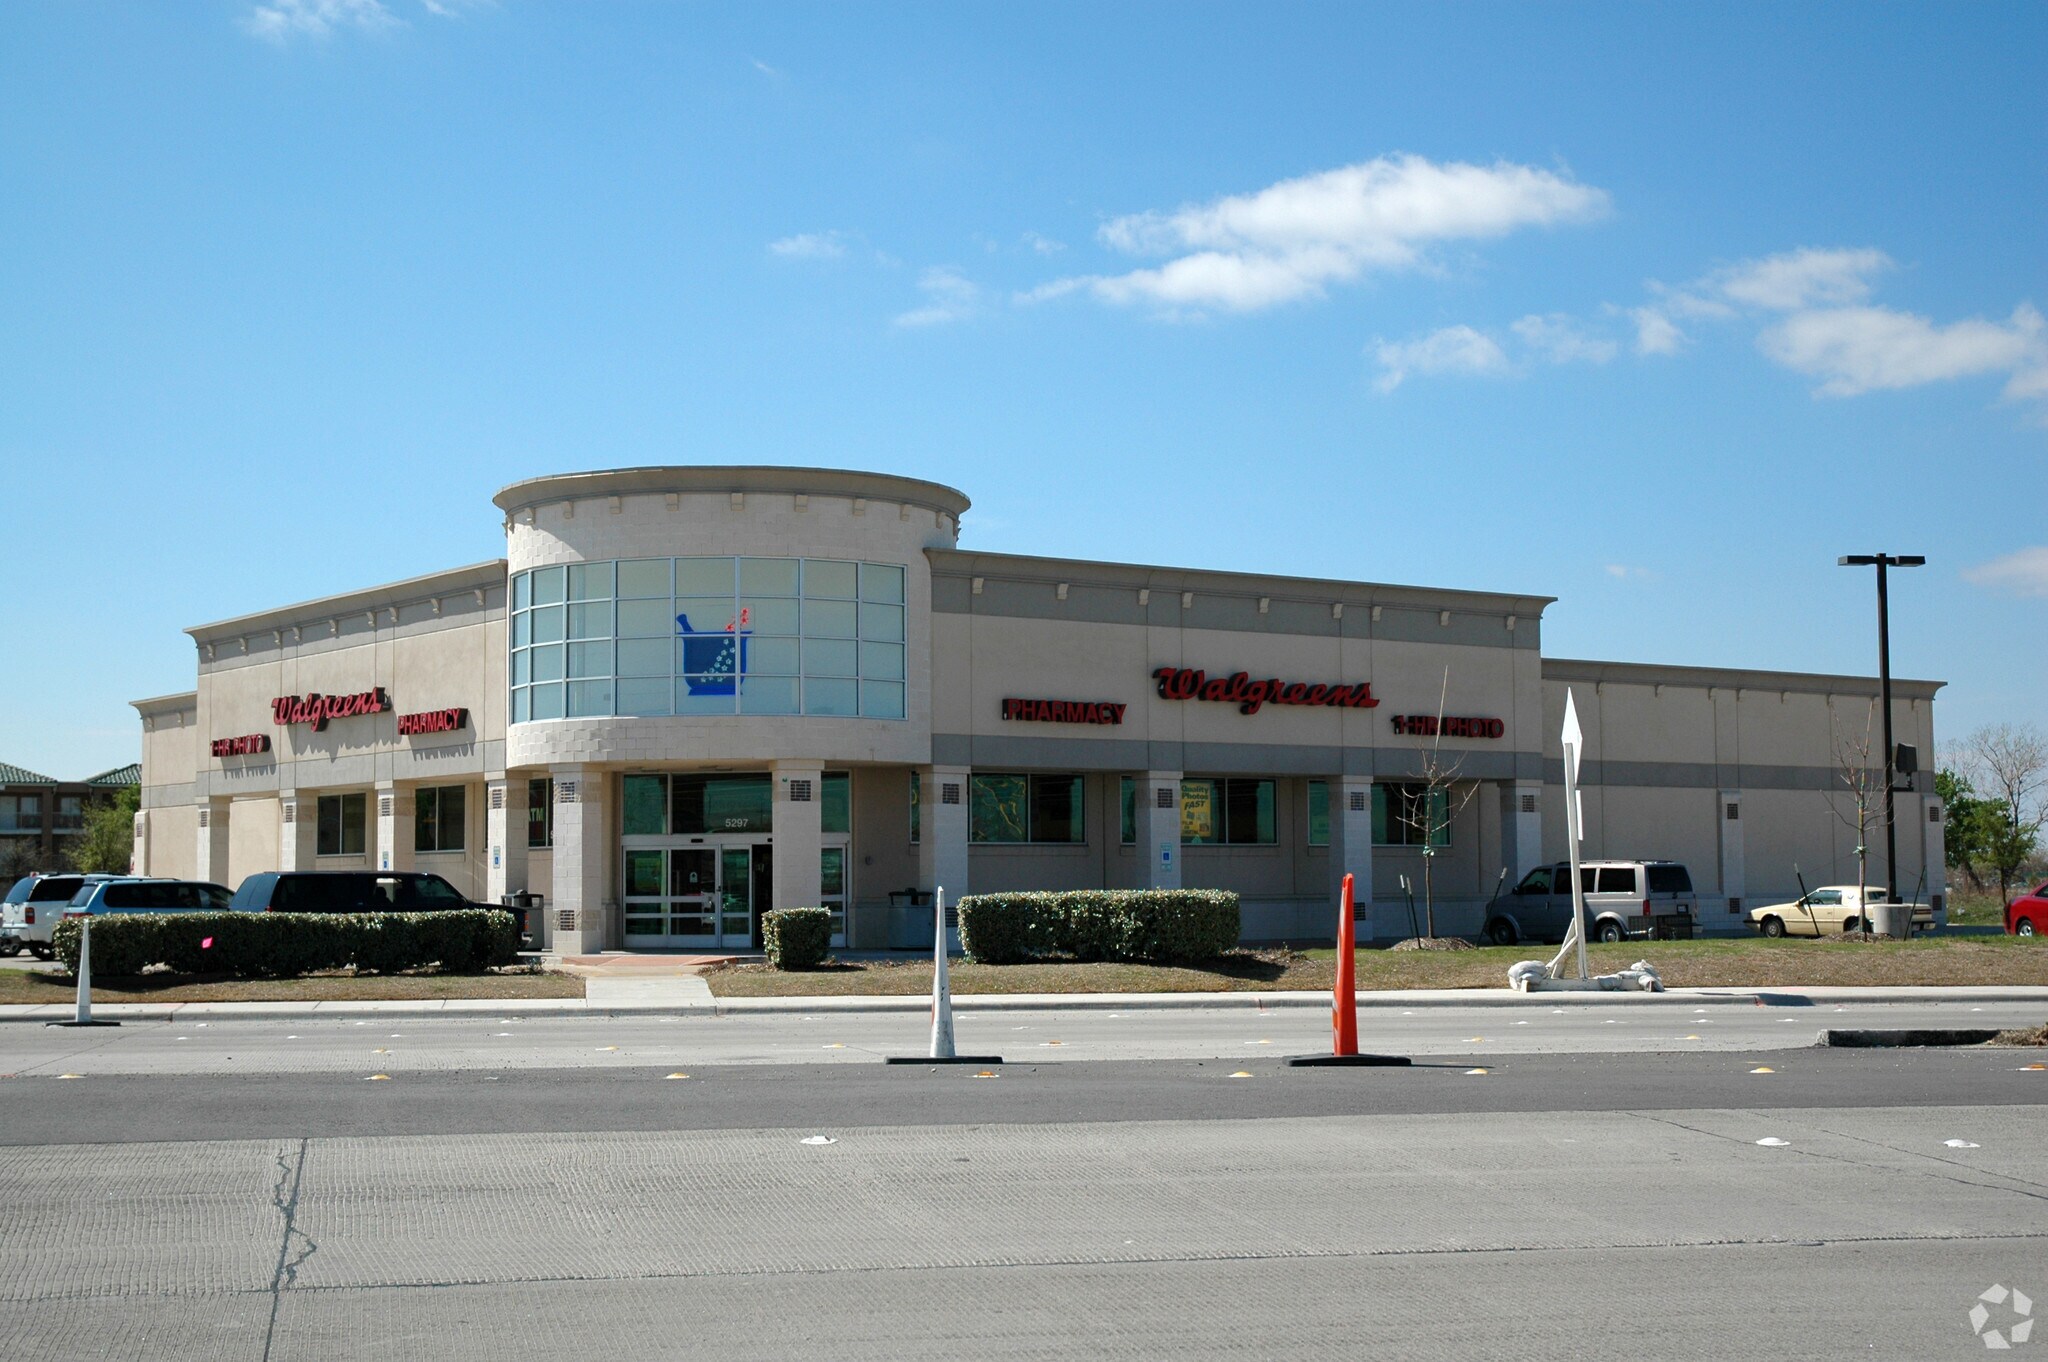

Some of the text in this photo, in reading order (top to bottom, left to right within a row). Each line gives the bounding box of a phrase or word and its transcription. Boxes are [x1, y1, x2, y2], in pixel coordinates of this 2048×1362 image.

[1155, 667, 1380, 715] Walgreens
[271, 687, 383, 732] Walgreens
[1006, 698, 1127, 725] PHARMACY
[398, 708, 461, 735] PHARMACY
[1446, 717, 1504, 738] PHOTO
[233, 733, 264, 755] PHOTO
[1181, 785, 1209, 795] Quality
[1181, 792, 1209, 800] Photos
[528, 807, 545, 822] TM
[1184, 801, 1206, 811] FAST
[725, 818, 749, 828] 5297
